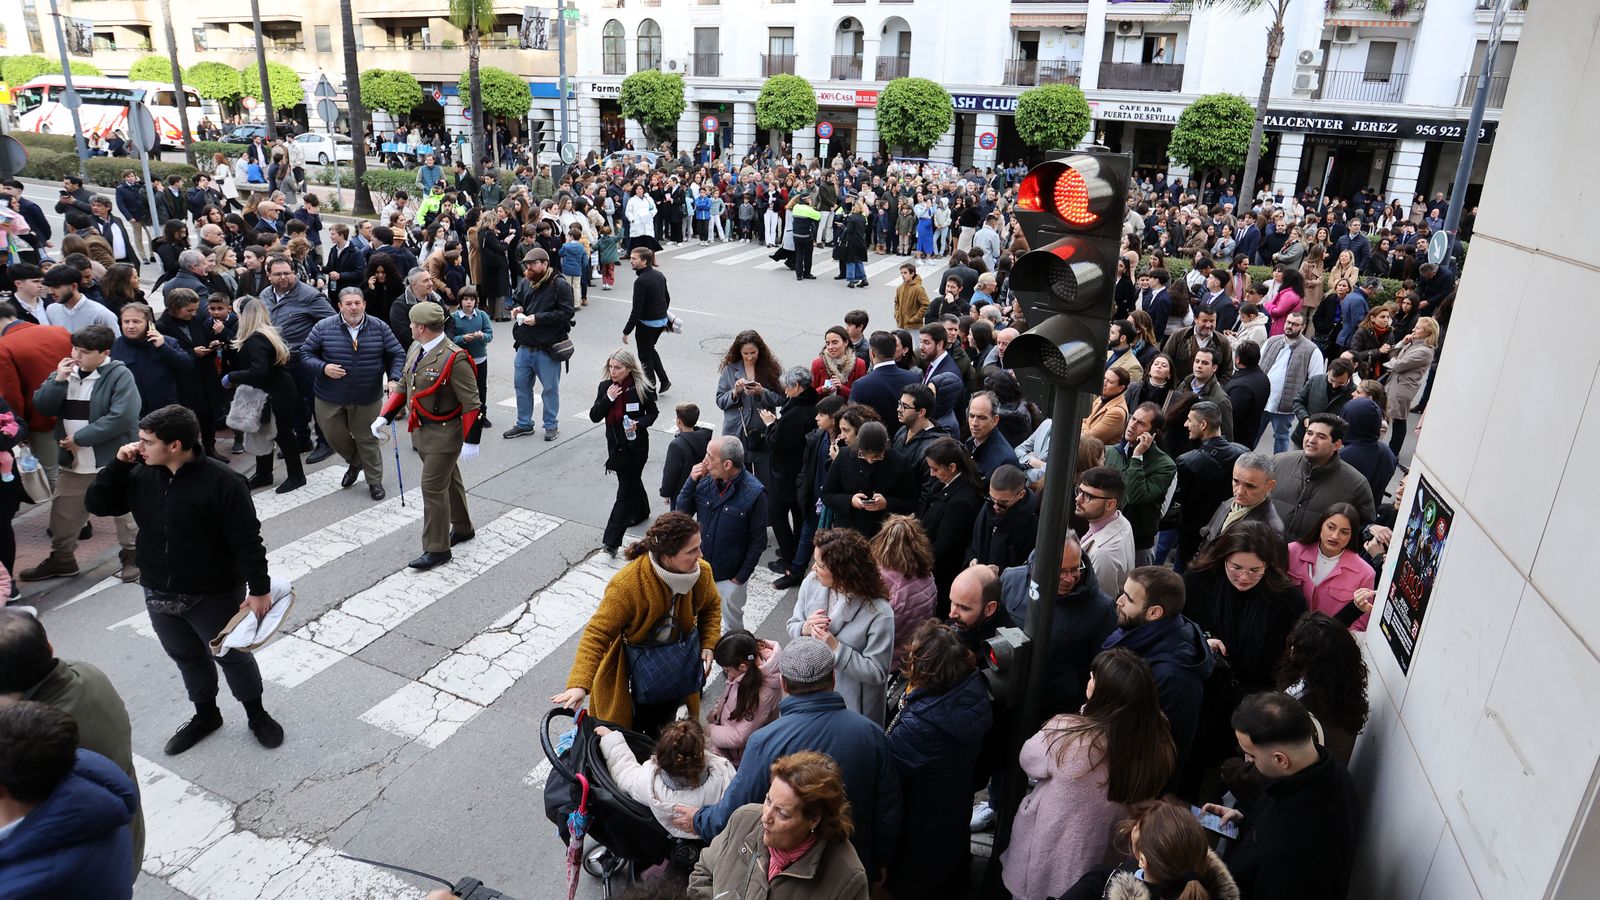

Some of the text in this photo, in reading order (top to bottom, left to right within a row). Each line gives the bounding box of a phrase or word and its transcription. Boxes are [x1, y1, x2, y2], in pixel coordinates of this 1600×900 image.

[592, 83, 620, 93] Farma
[951, 97, 977, 109] ASH
[1119, 104, 1141, 112] CAFE
[1103, 110, 1176, 122] PUERTA DE SEVILLA
[1263, 115, 1343, 130] TALCENTER
[1352, 121, 1398, 133] JEREZ
[1415, 124, 1437, 135] 956
[1439, 126, 1461, 137] 922
